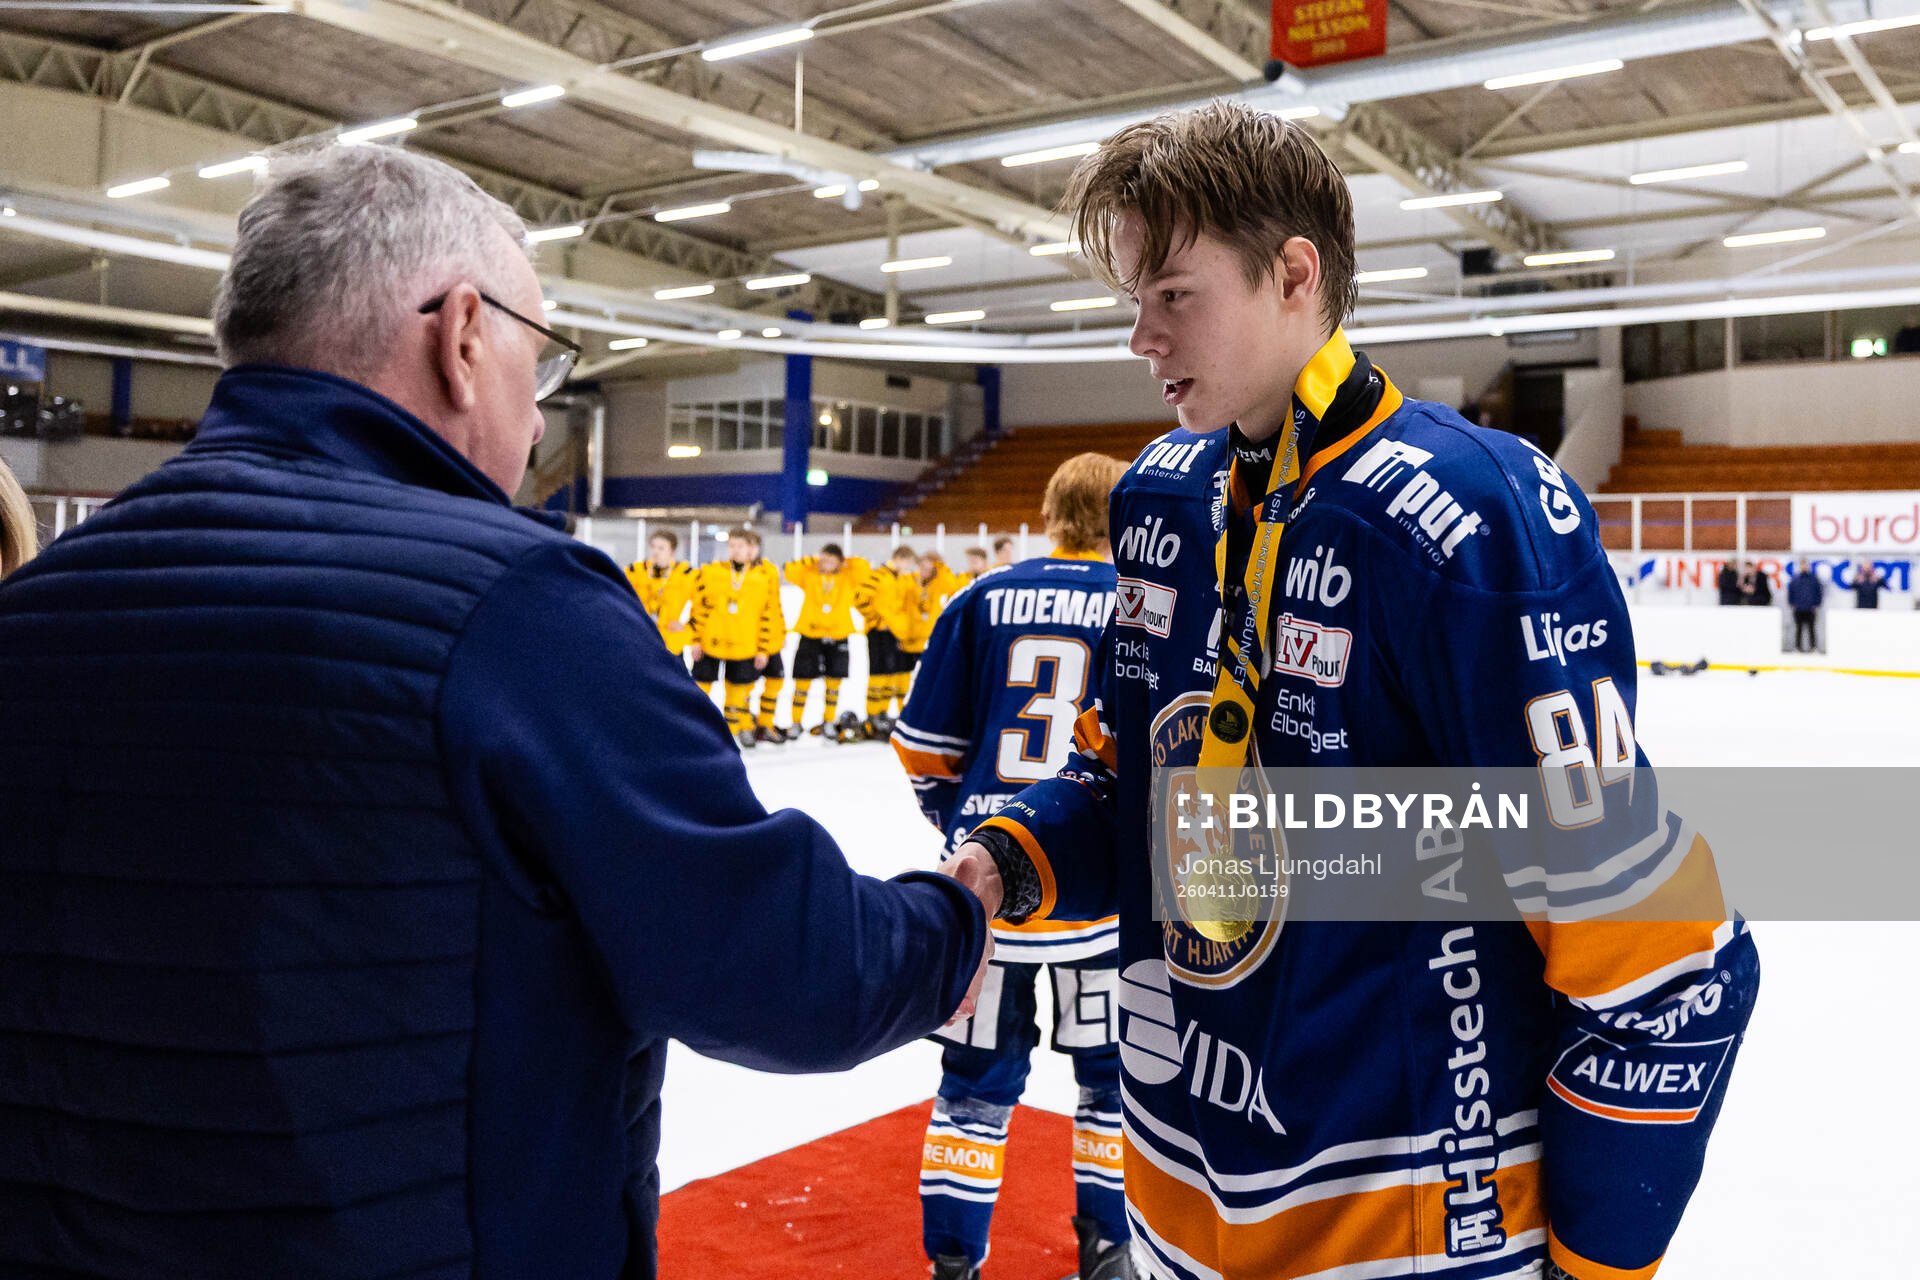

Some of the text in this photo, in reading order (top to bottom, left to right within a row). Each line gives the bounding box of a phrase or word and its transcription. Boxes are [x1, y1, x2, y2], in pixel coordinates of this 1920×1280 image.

[1278, 688, 1316, 716] Enkl
[1523, 676, 1637, 830] 84
[1415, 817, 1469, 904] AB
[1429, 926, 1497, 1205] Hisstech
[1572, 1054, 1707, 1093] ALWEX
